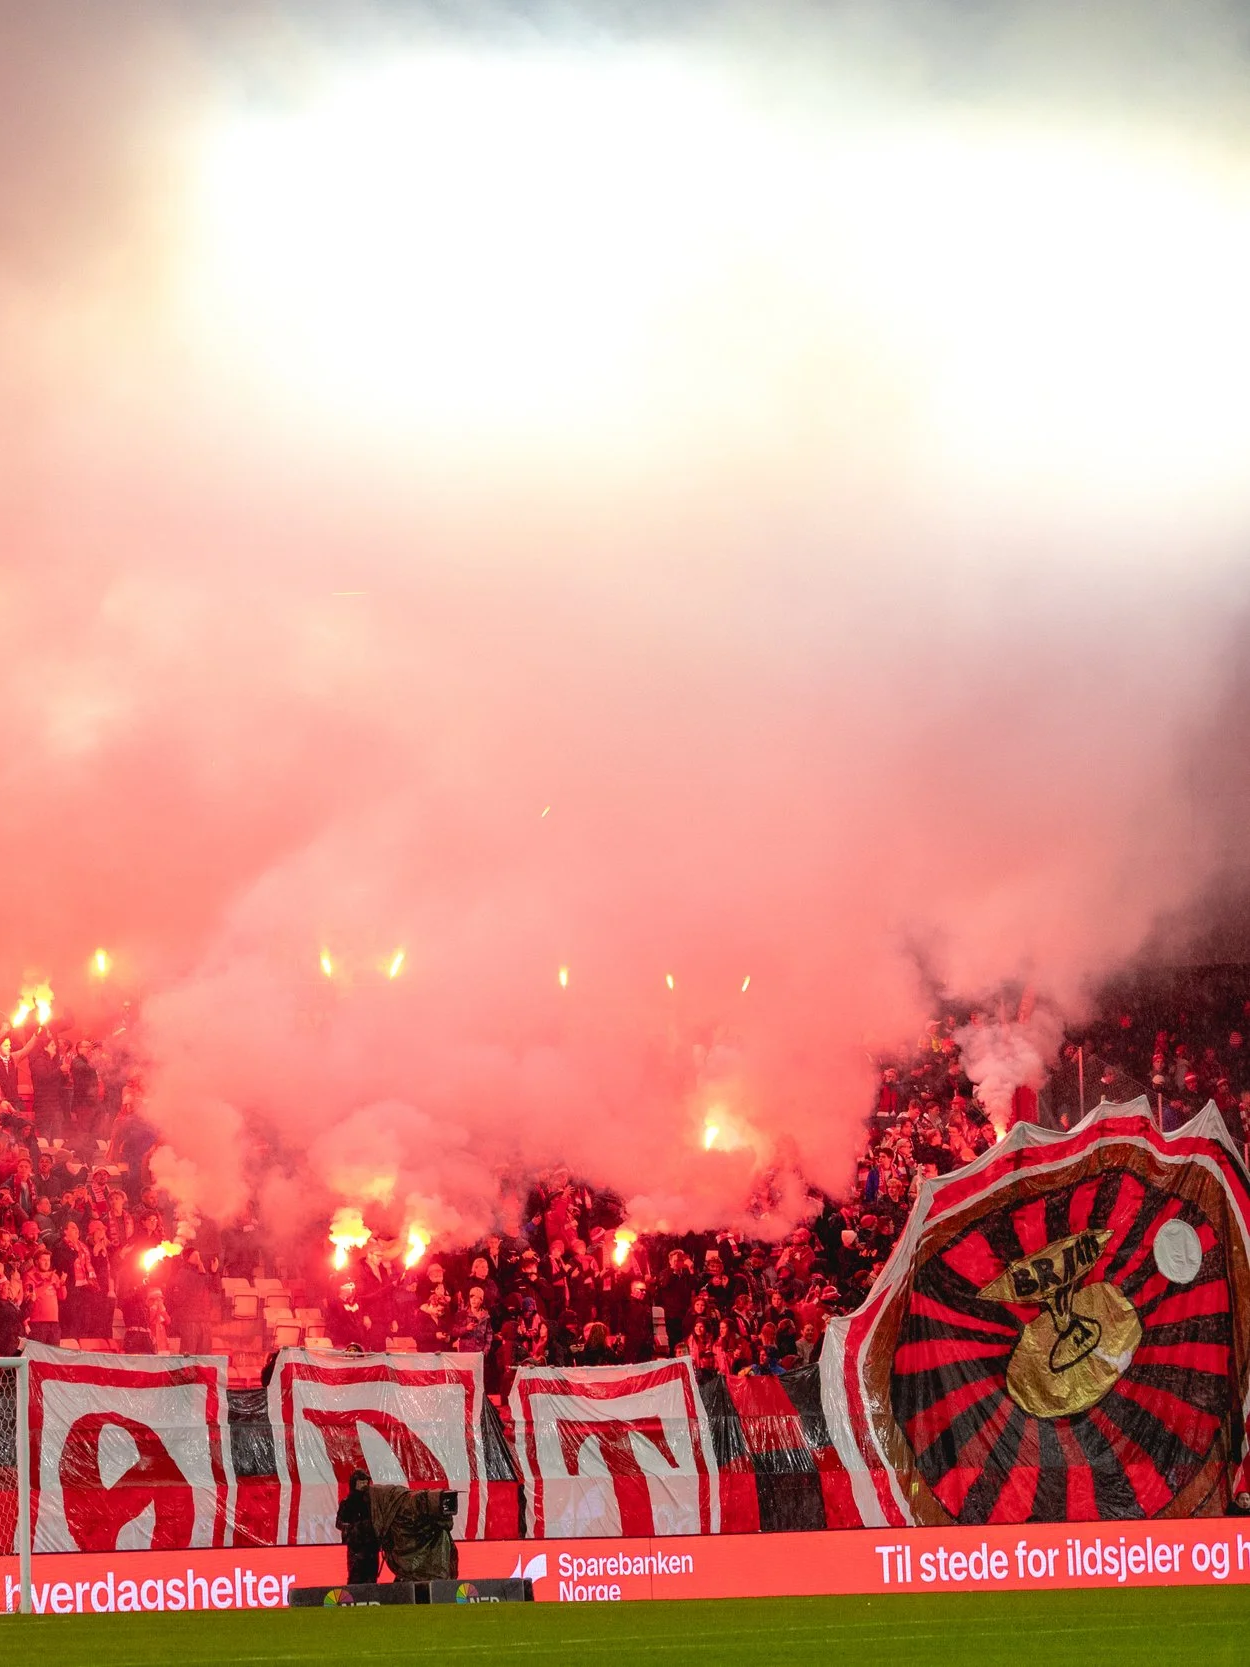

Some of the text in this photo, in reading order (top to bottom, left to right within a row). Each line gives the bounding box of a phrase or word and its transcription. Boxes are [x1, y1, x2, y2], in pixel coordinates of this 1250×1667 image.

[558, 1551, 694, 1581] Sparebanken
[875, 1545, 912, 1584] Til
[920, 1543, 1008, 1582] stede
[1014, 1540, 1059, 1578] for
[1066, 1537, 1184, 1582] ildsjeler
[1191, 1542, 1230, 1579] og
[559, 1580, 621, 1602] Norge
